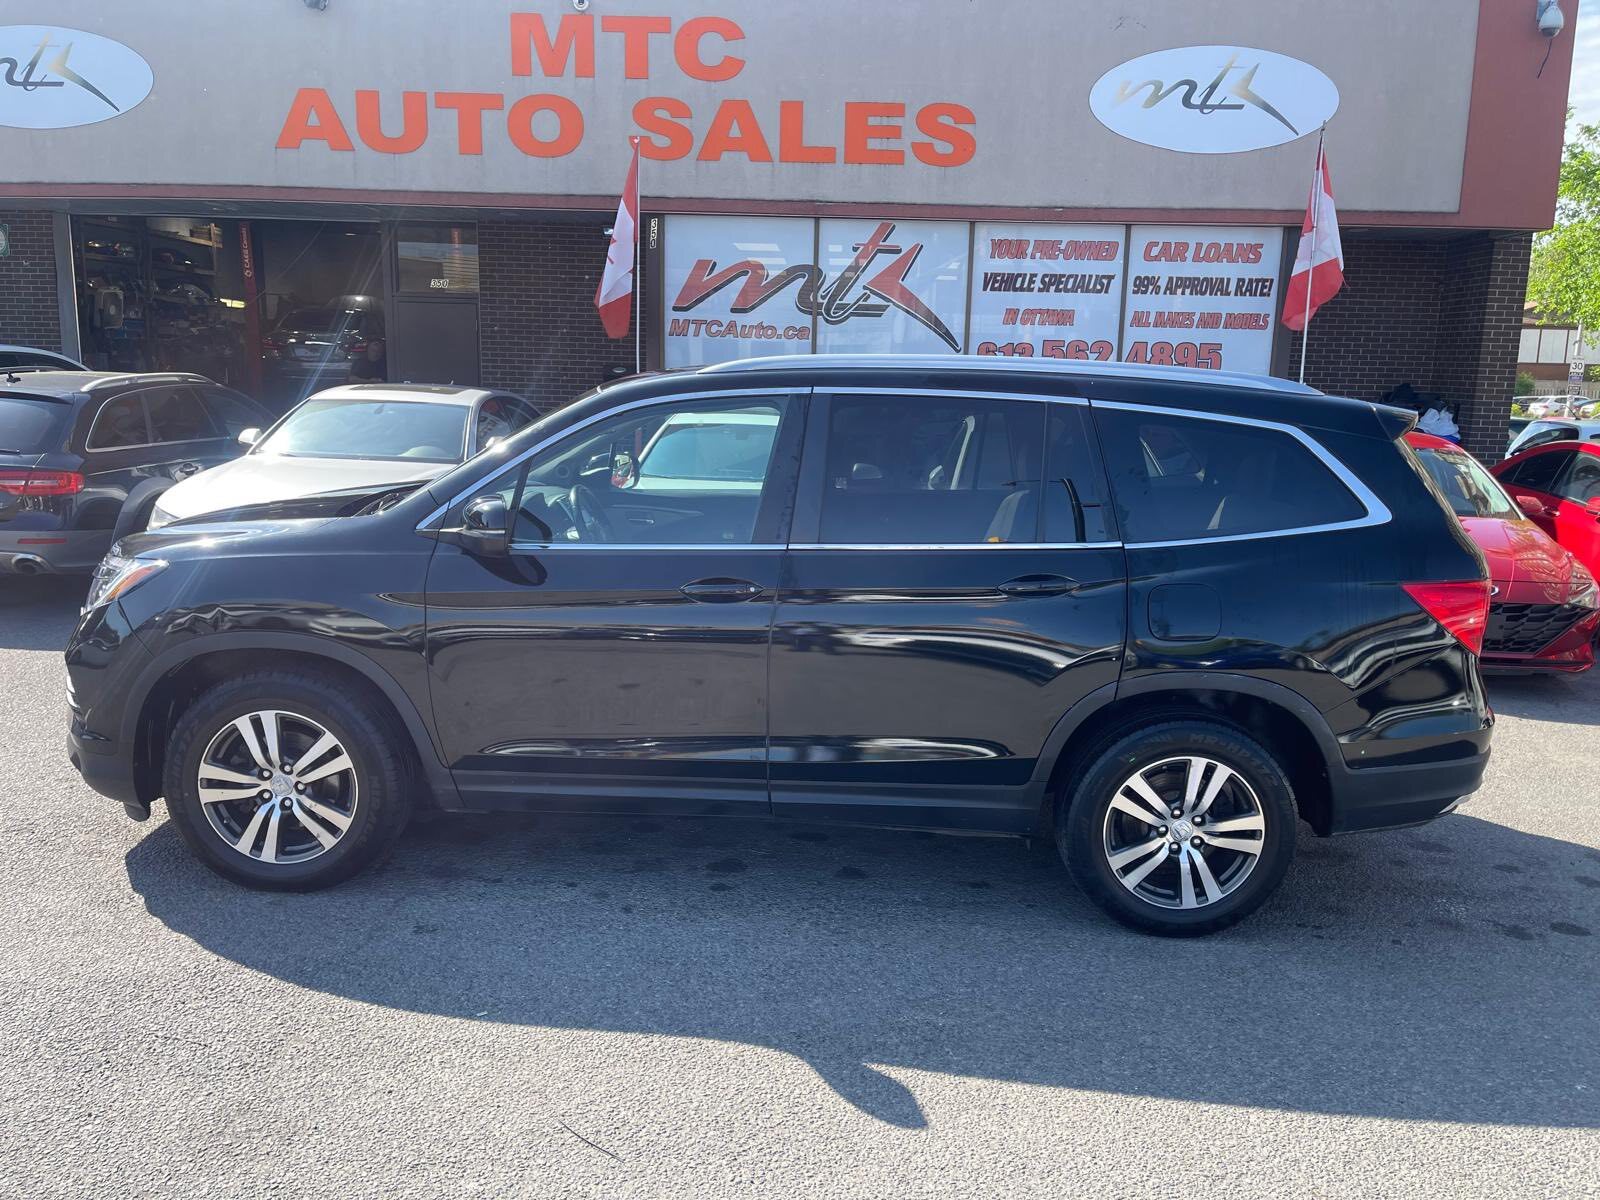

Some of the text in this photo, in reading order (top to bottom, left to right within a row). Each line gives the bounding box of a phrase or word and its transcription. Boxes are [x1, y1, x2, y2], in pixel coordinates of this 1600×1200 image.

[509, 12, 746, 82] MTC
[275, 87, 977, 168] AUTO SALES
[650, 218, 658, 248] 350
[990, 238, 1120, 262] YOUR PRE-OWNED
[1143, 241, 1265, 264] CAR LOANS
[982, 271, 1116, 294] VEHICLE SPECIALIST
[1132, 275, 1275, 298] 99% APPROVAL RATE!
[1002, 307, 1076, 327] IN OTTAWA
[1130, 310, 1271, 331] ALL MAKES AND MODELS
[668, 319, 810, 340] MTCAuto.ca
[1572, 362, 1583, 370] 30
